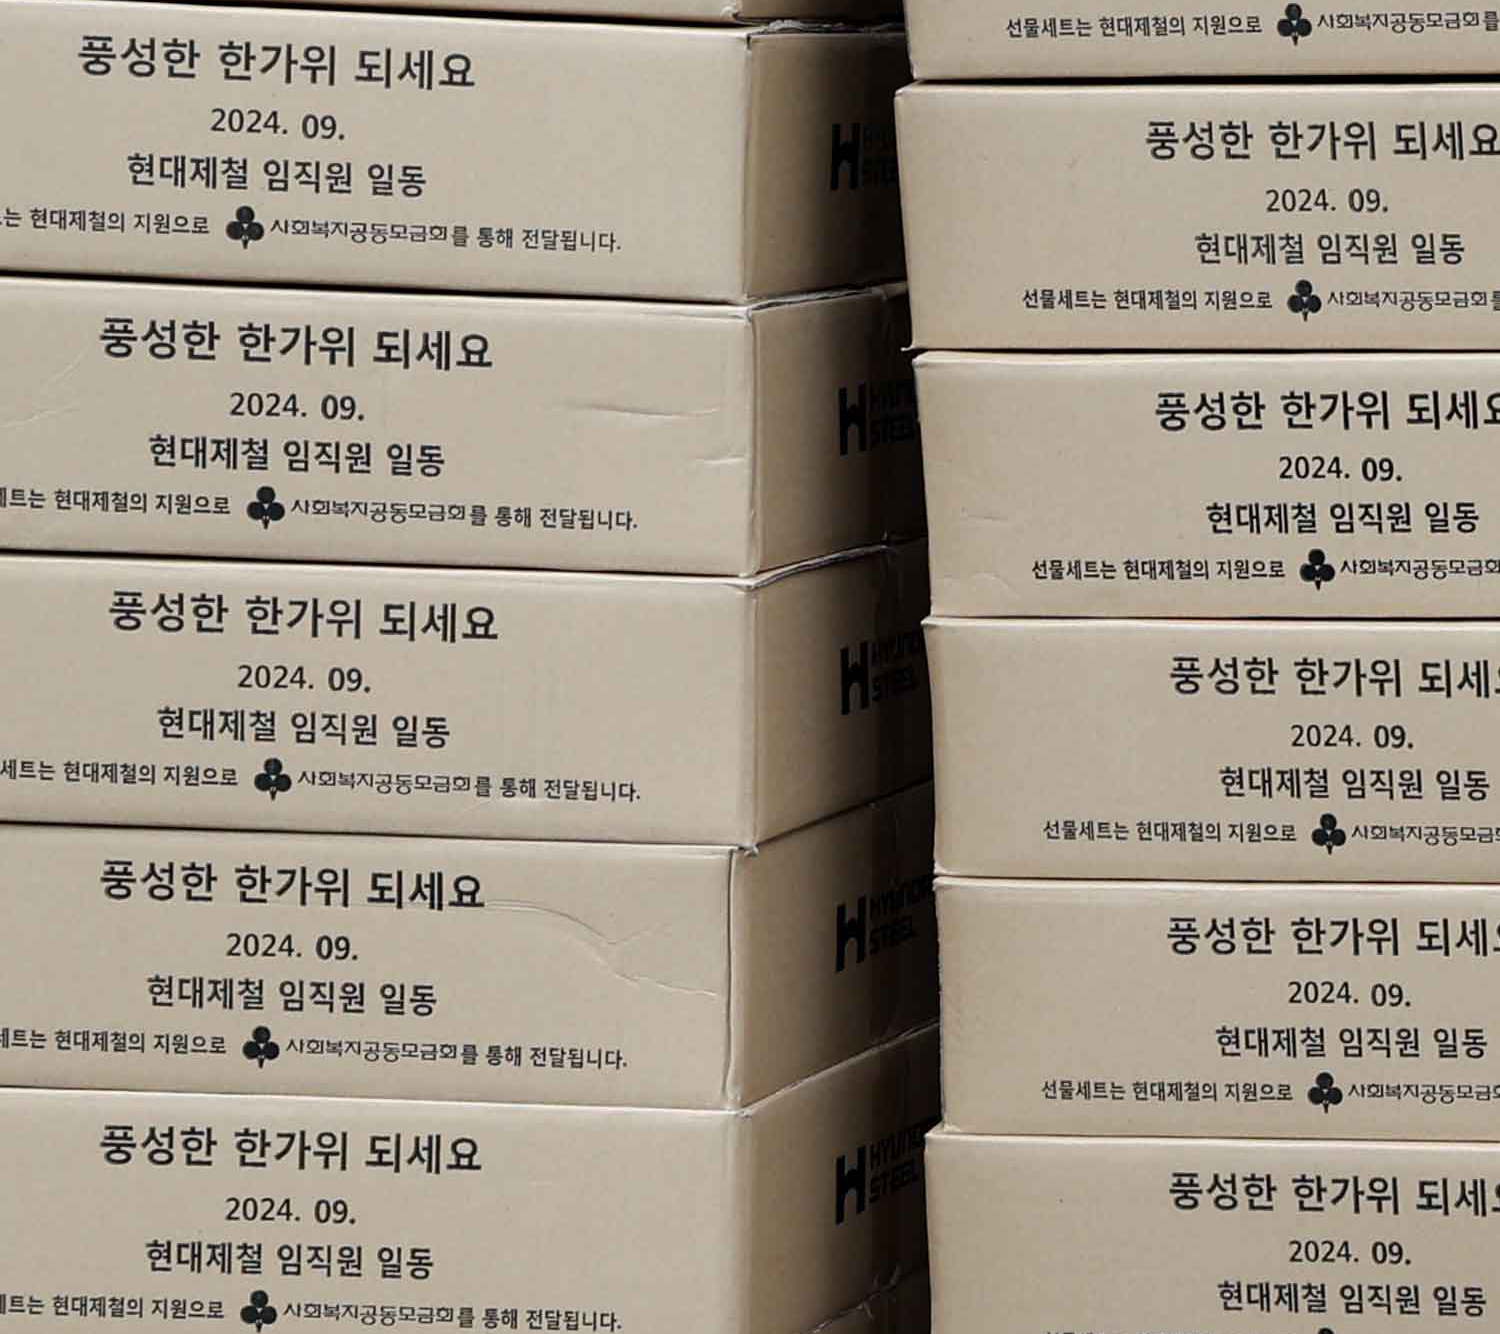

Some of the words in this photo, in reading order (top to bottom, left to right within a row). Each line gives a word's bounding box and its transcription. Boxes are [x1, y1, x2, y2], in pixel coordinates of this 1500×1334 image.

[99, 1124, 218, 1167] 풍성한
[233, 1127, 348, 1172] 한가위
[364, 1132, 483, 1176] 되세요
[1168, 1172, 1278, 1212] 풍성한
[1291, 1173, 1400, 1216] 한가위
[1288, 1239, 1360, 1263] 2024.
[1371, 1240, 1412, 1266] 09.
[1217, 1279, 1328, 1314] 현대제철
[1339, 1282, 1421, 1316] 임직원
[1432, 1285, 1487, 1318] 일동
